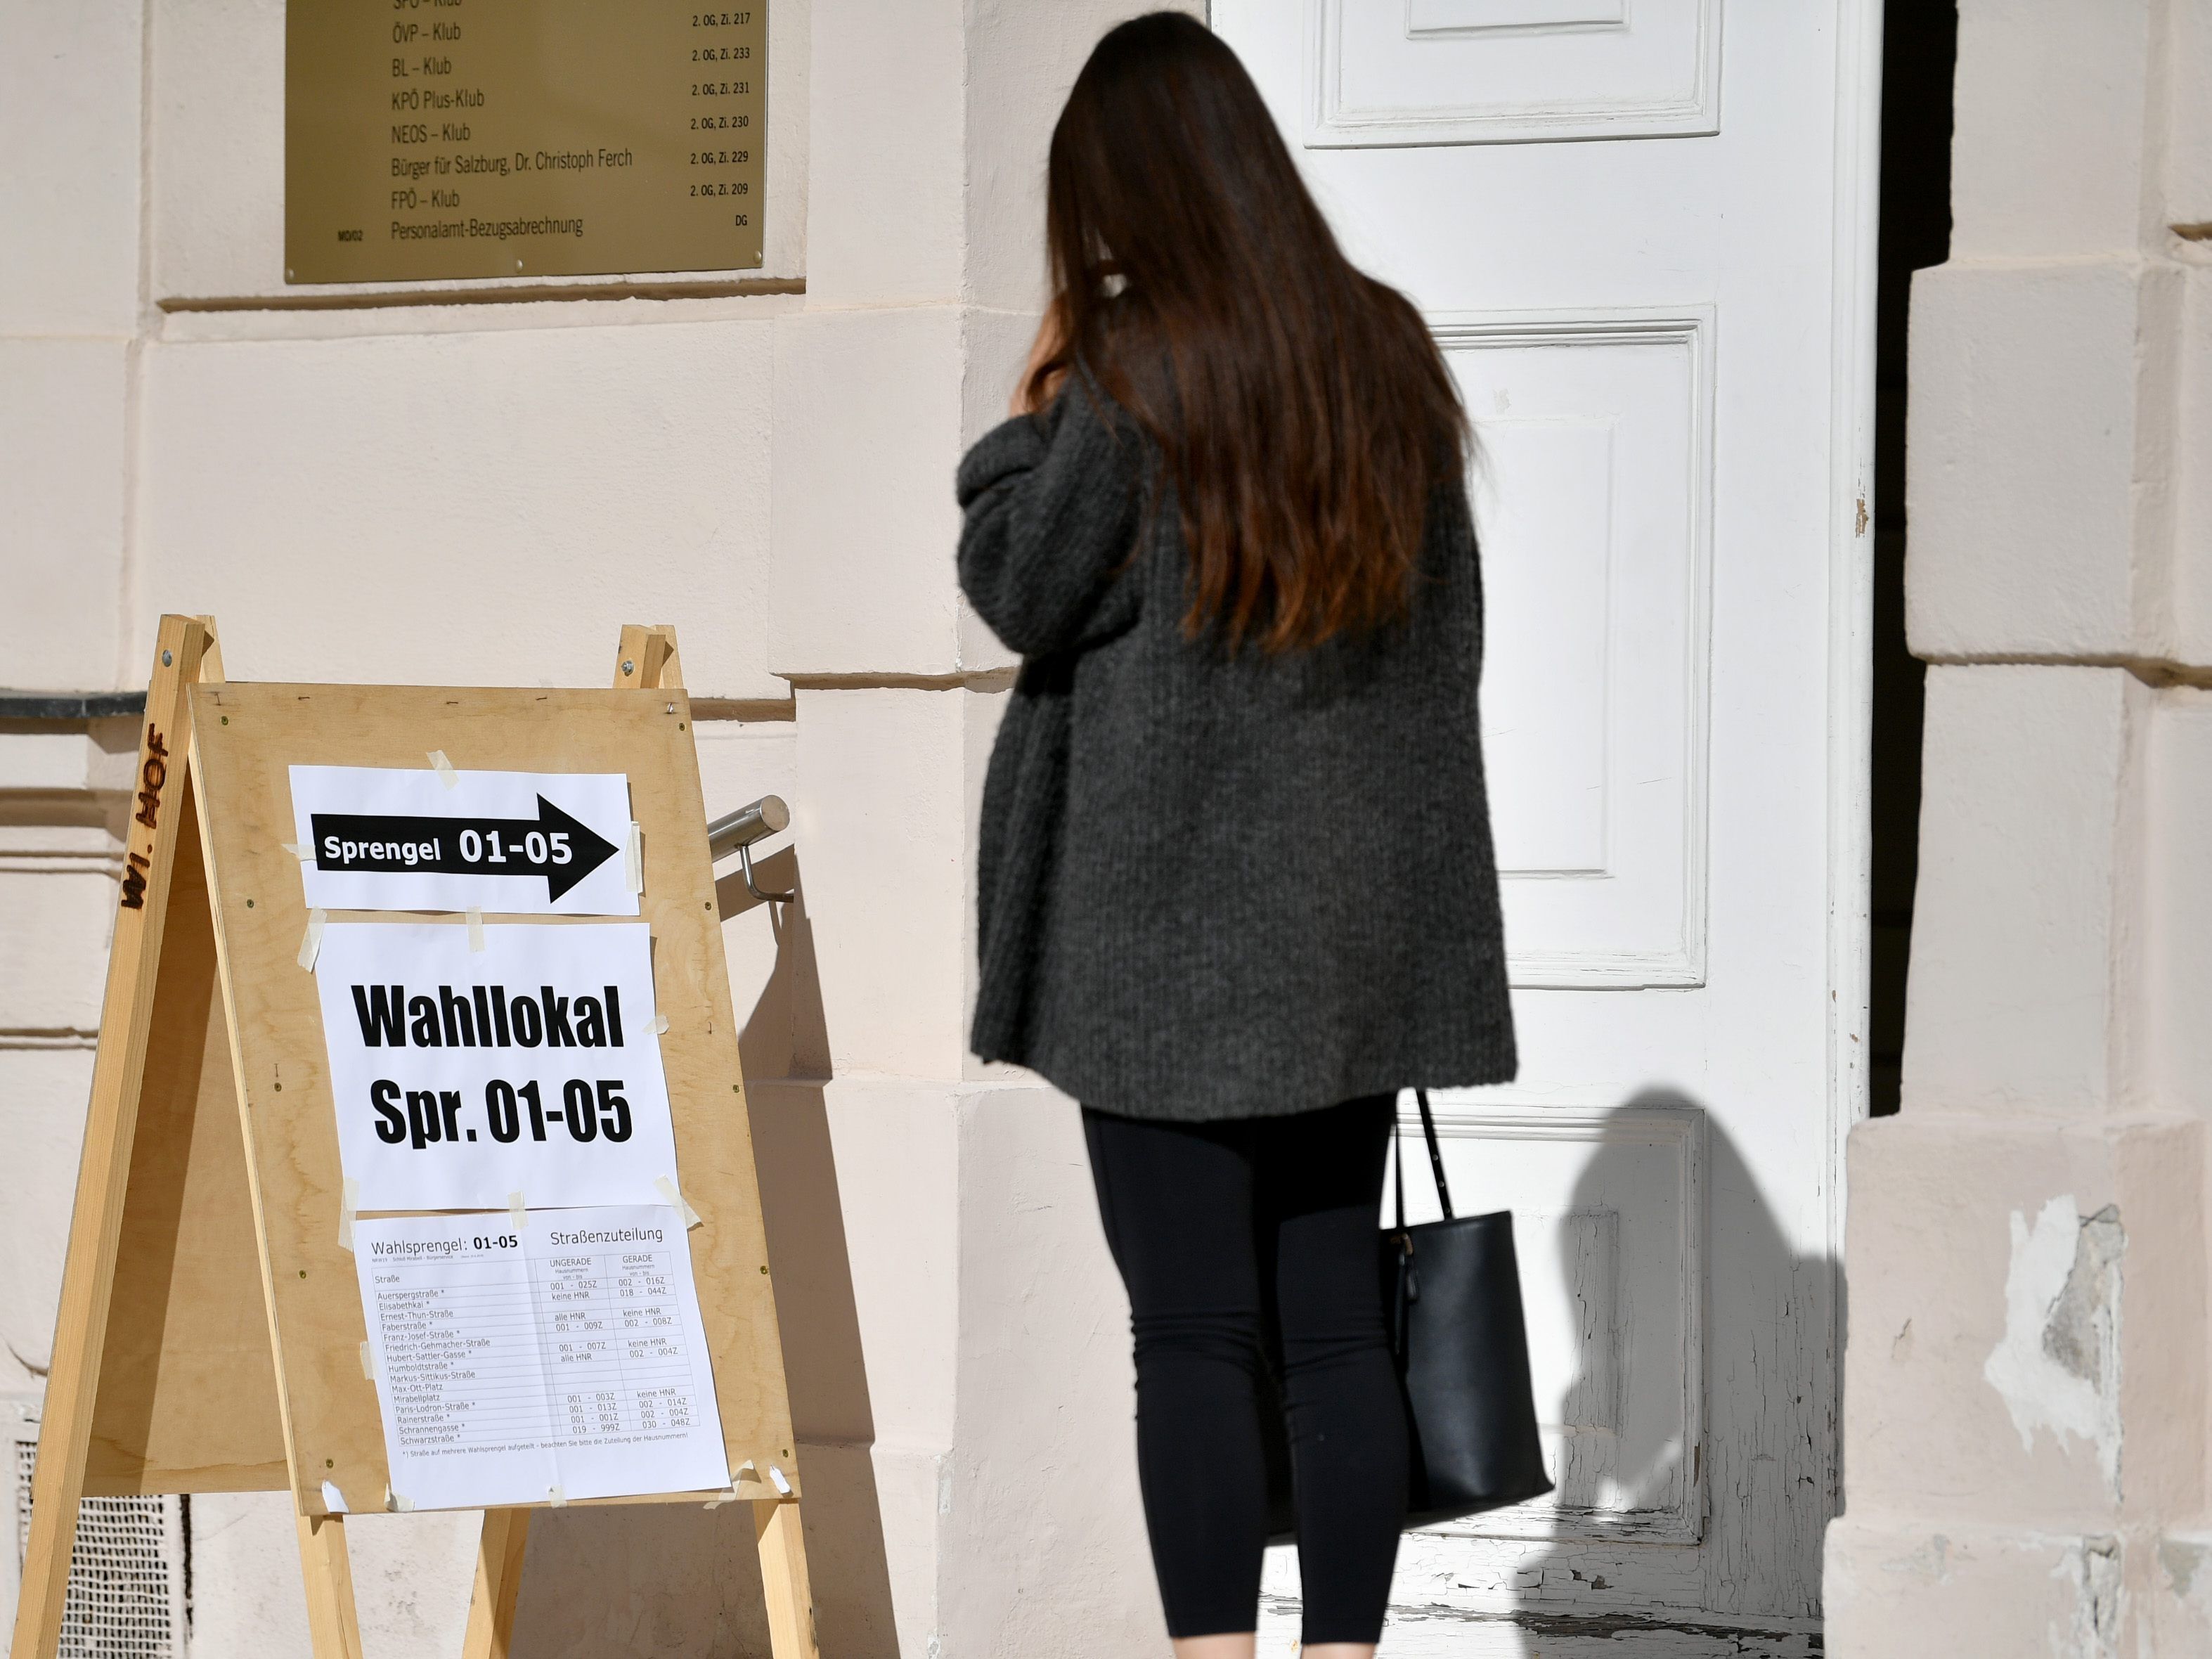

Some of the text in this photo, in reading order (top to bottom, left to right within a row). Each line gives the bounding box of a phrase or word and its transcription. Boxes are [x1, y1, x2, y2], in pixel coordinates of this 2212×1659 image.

[692, 12, 751, 27] 2. OG, Zi. 217
[392, 22, 419, 43] ÖVP
[433, 22, 461, 41] Klub
[692, 47, 751, 62] 2. OG, Zi. 233
[392, 58, 410, 77] BL
[423, 56, 452, 75] Klub
[692, 82, 749, 97] 2. OG, Zi. 231
[392, 88, 485, 110] KPÖ Plus-Klub
[690, 115, 749, 131] 2. OG, Zi. 230
[392, 124, 427, 143] NEOS
[443, 122, 471, 141] Klub
[690, 150, 749, 165] 2. OG, Zi. 229
[392, 148, 633, 180] Bürger für Salzburg, Dr. Christoph Ferch
[690, 183, 748, 197] 2. OG, Zi. 209
[391, 187, 417, 209] FPÖ
[432, 189, 460, 208] Klub
[735, 214, 747, 226] DG
[391, 215, 583, 240] Personalamt-Bezugsabrechnung
[136, 723, 169, 830] HOF
[324, 829, 573, 865] Sprengel 01-05
[351, 985, 624, 1047] Wahllokal
[370, 1079, 633, 1149] Spr. 01-05
[550, 1227, 663, 1245] Straßenzuteilung
[371, 1235, 519, 1255] Wahlsprengel: 01-05
[550, 1257, 592, 1267] UNGERADE
[623, 1254, 652, 1263] GERADE
[375, 1274, 400, 1284] Straße
[646, 1277, 665, 1285] 016Z
[550, 1282, 564, 1291] 001
[578, 1280, 597, 1289] 025Z
[647, 1286, 667, 1295] 044Z
[377, 1289, 439, 1300] Auerspergstraße
[552, 1291, 590, 1300] keine HNR
[380, 1300, 424, 1310] Elisabethkai
[381, 1310, 454, 1322] Ernest-Thun-Straße
[555, 1312, 586, 1322] alle HNR
[623, 1308, 661, 1317] keine HNR
[382, 1322, 427, 1331] Faberstraße
[555, 1323, 569, 1331] 001
[584, 1322, 603, 1330] 009Z
[624, 1319, 639, 1327] 002
[652, 1317, 672, 1326] 008Z
[384, 1330, 454, 1341] Franz-Josef-Straße
[385, 1338, 491, 1352] Friedrich-Gehmacher-Straße
[560, 1344, 573, 1353] 001
[587, 1342, 607, 1351] 007Z
[628, 1338, 668, 1348] keine HNR
[387, 1350, 466, 1362] Hubert-Sattler-Gasse
[561, 1353, 592, 1362] alle HNR
[630, 1350, 644, 1358] 002
[658, 1347, 678, 1356] 004Z
[388, 1362, 448, 1372] Humboldtstraße
[390, 1371, 476, 1383] Markus-Sittikus-Straße
[392, 1383, 444, 1393] Max-Ott-Platz
[637, 1388, 676, 1399] keine HNR
[394, 1395, 440, 1404] Mirabellplatz
[567, 1395, 582, 1403] 001
[596, 1392, 616, 1401] 003Z
[638, 1400, 654, 1409] 002
[668, 1397, 687, 1406] 014Z
[395, 1402, 470, 1414] Paris-Lodron-Straße
[569, 1405, 583, 1413] 001
[597, 1403, 617, 1412] 013Z
[641, 1410, 655, 1419] 002
[669, 1407, 689, 1416] 004Z
[397, 1414, 444, 1424] Rainerstraße
[599, 1413, 619, 1421] 001Z
[572, 1426, 587, 1434] 019
[600, 1423, 621, 1432] 999Z
[642, 1418, 691, 1429] 030 048Z
[399, 1424, 459, 1435] Schrannengasse
[401, 1434, 454, 1445] Schwarzstraße
[410, 1450, 429, 1458] Straße
[467, 1445, 506, 1454] Wahlsprengel
[507, 1443, 535, 1452] aufgeteilt
[540, 1441, 567, 1450] beachten
[604, 1437, 631, 1445] Zuteilung
[644, 1433, 689, 1442] Hausnummern!
